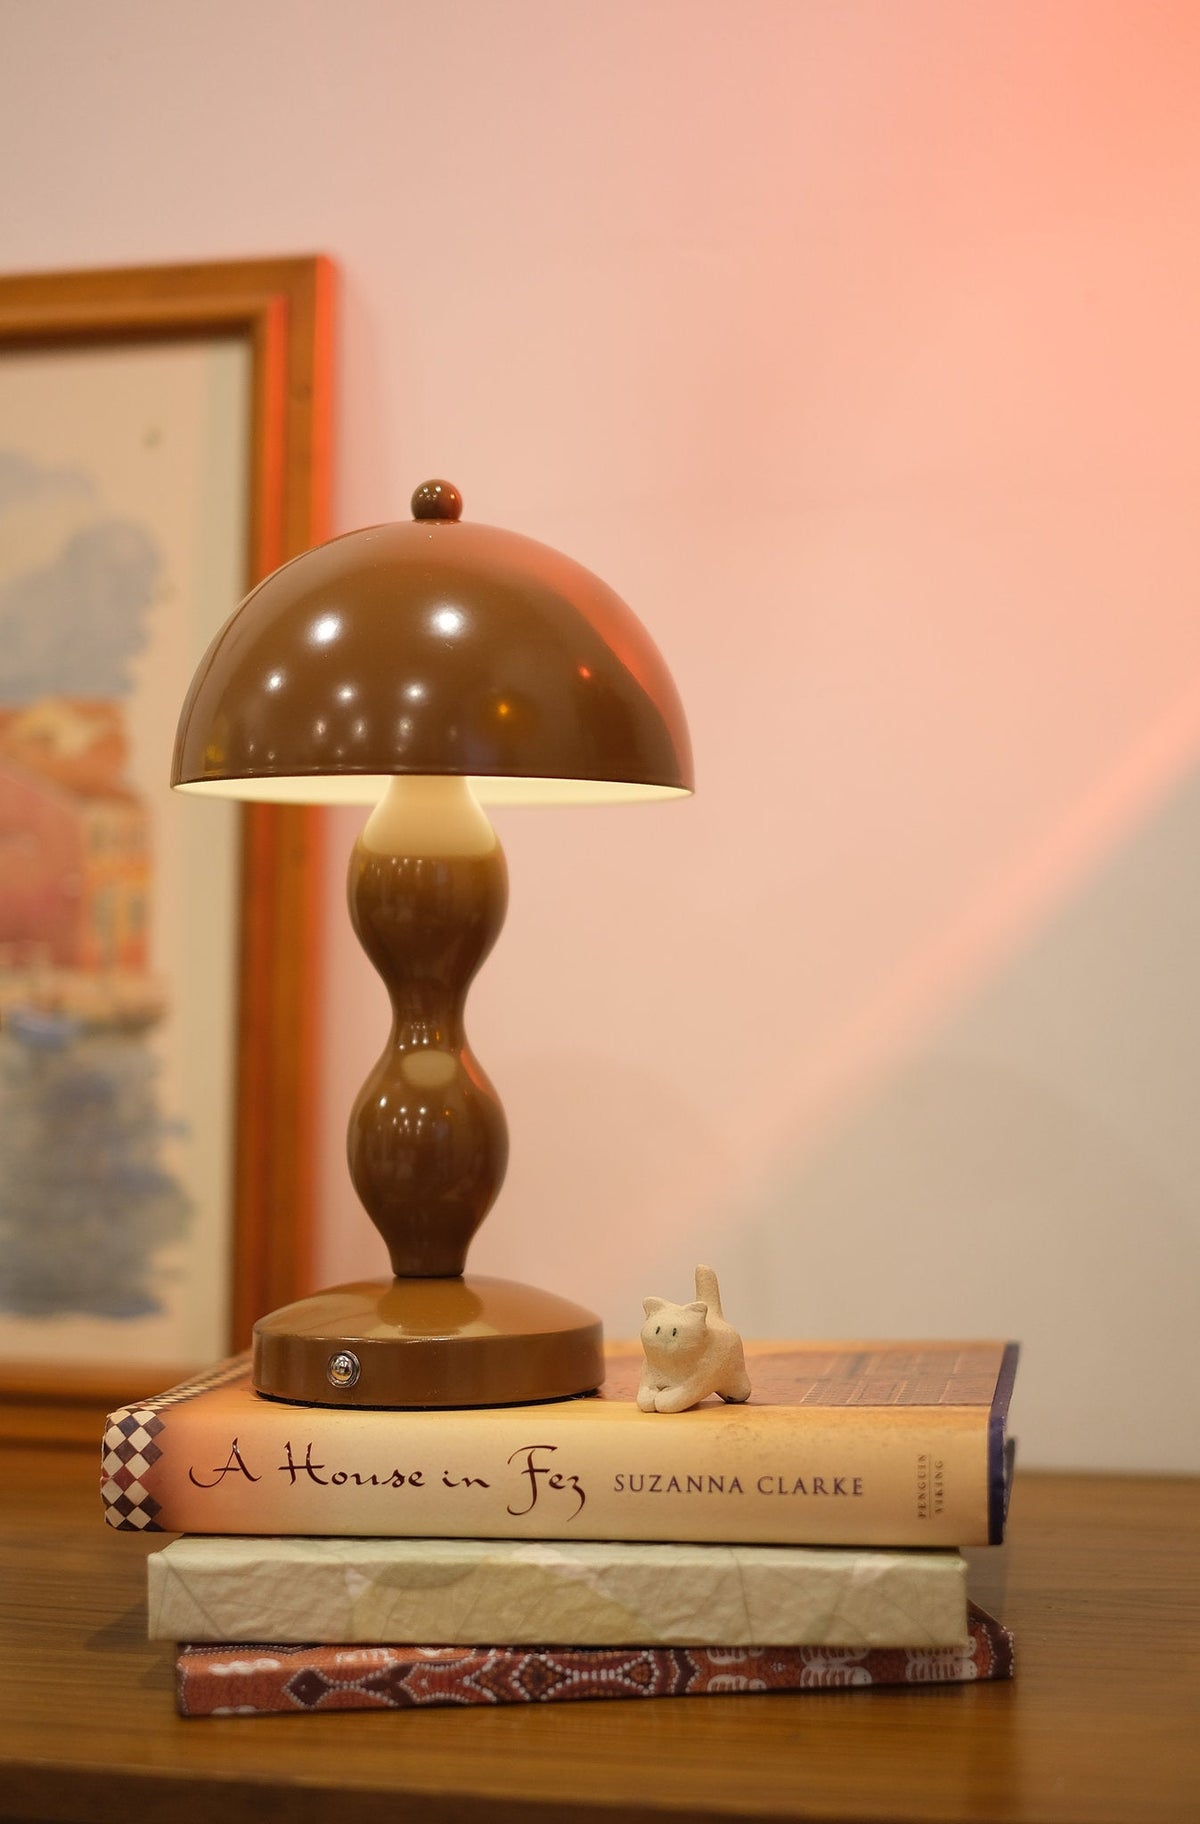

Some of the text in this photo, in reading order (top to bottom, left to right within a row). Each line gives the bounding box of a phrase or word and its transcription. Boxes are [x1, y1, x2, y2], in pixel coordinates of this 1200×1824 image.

[188, 1437, 587, 1522] A House in Fez
[613, 1473, 865, 1496] SUZANNA CLARKE
[917, 1453, 927, 1518] PENGUIN
[934, 1460, 944, 1514] VIKING
